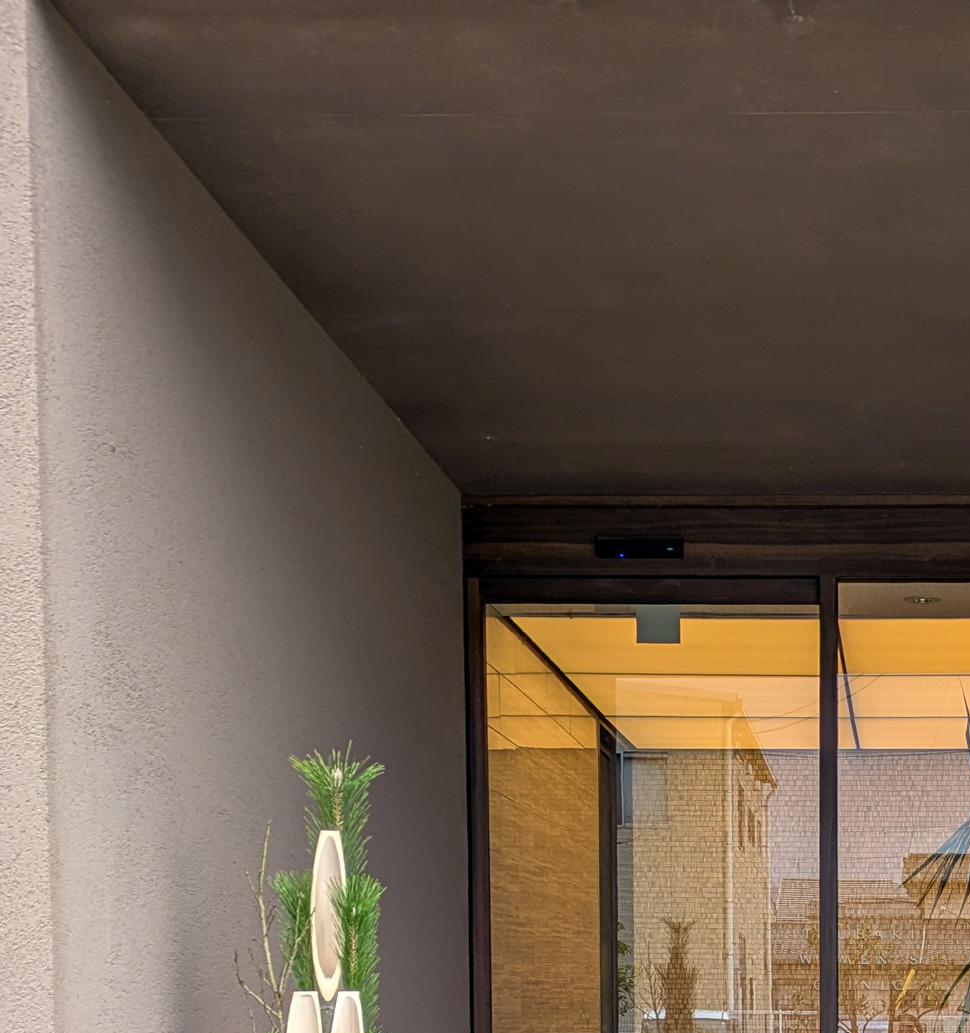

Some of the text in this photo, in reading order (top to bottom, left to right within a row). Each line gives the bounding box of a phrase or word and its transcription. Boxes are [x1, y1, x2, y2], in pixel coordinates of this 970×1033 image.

[803, 928, 914, 940] TUBAKI
[799, 954, 918, 965] WMEN'S
[813, 980, 904, 991] CINIC
